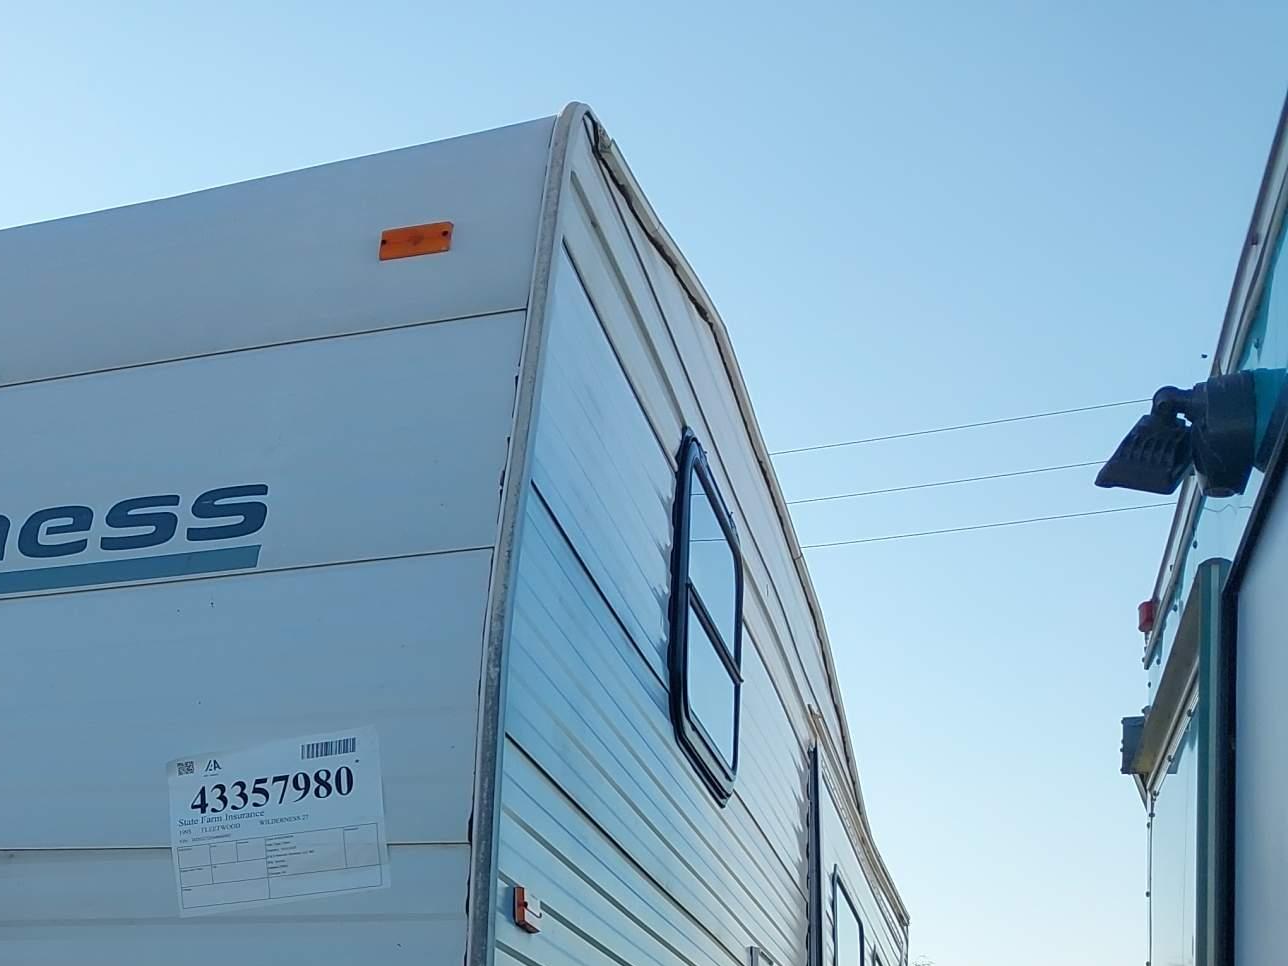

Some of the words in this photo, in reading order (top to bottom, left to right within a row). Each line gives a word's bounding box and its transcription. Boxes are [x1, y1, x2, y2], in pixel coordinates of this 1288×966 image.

[190, 765, 354, 815] 43357980
[178, 817, 199, 828] State
[201, 814, 223, 825] Farm
[225, 810, 265, 822] Insurance
